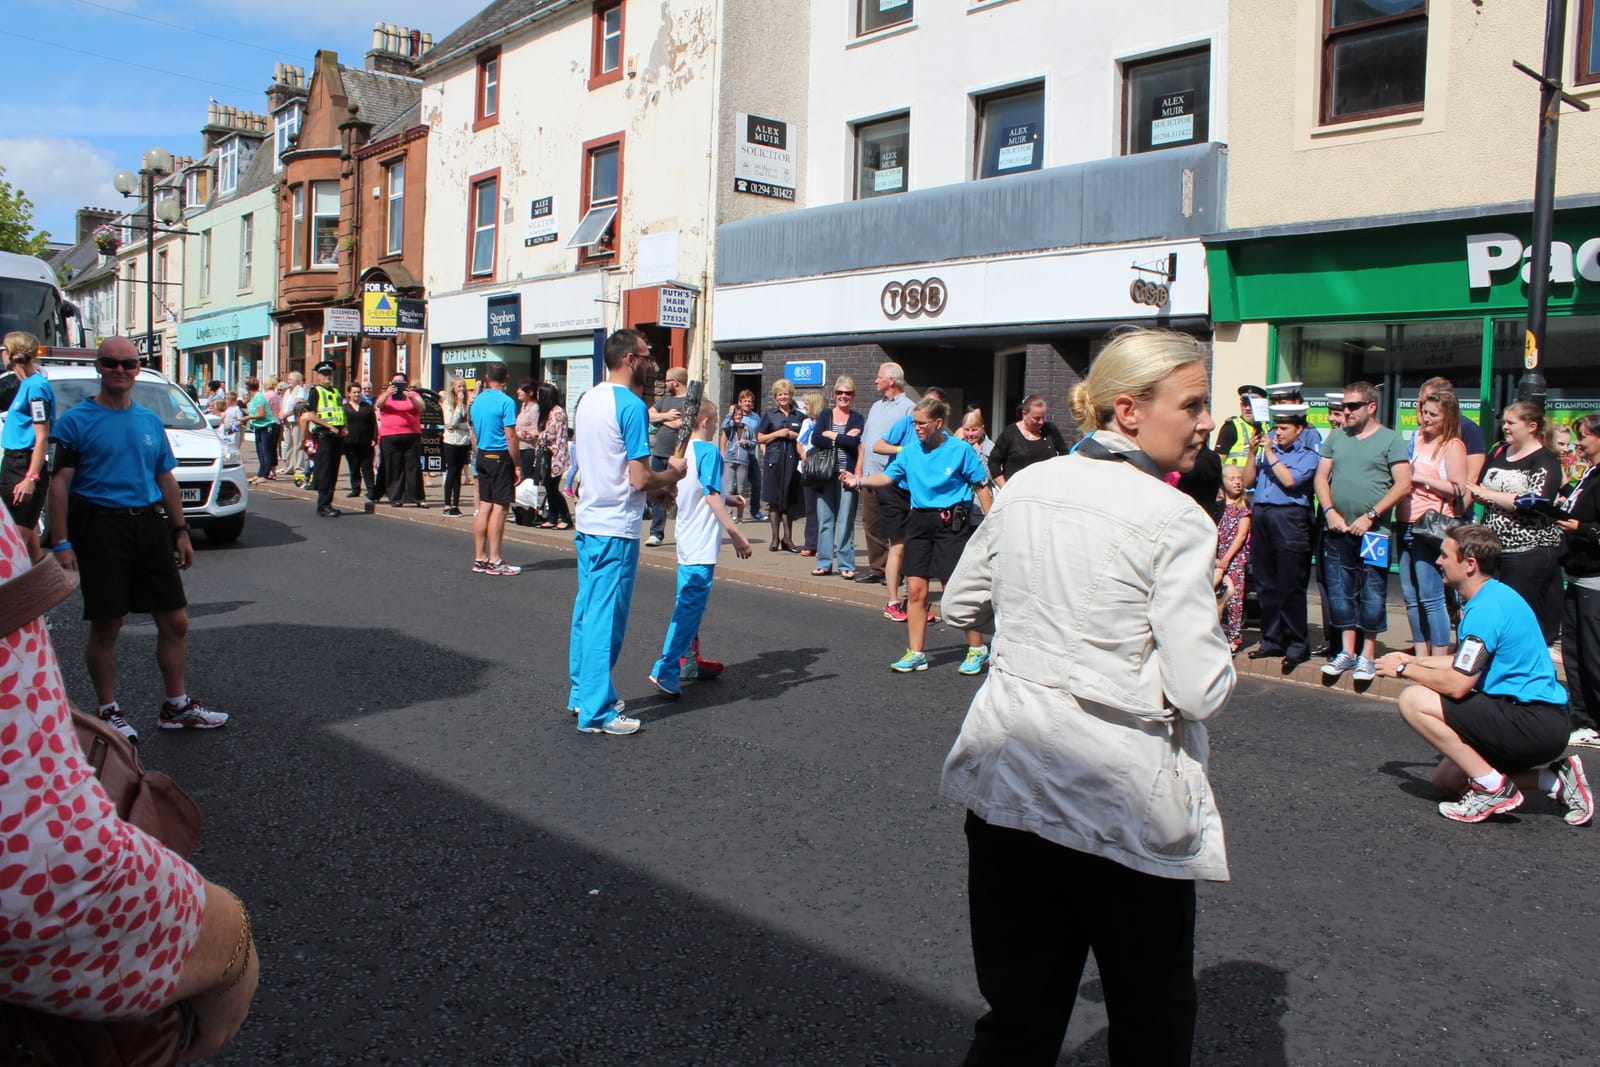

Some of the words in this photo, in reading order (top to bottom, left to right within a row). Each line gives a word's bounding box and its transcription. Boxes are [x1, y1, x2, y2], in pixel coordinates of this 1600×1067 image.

[1162, 96, 1184, 107] ALEX
[1162, 106, 1184, 117] MUIR
[755, 124, 779, 136] ALEX
[1009, 127, 1028, 136] ALEX
[754, 133, 780, 144] MUIR
[1008, 136, 1026, 145] MUIR
[741, 145, 791, 163] SOLICITOR
[882, 152, 897, 160] ALEX
[750, 183, 771, 194] 01294
[772, 187, 793, 199] 311422
[365, 283, 381, 292] FOR
[384, 284, 396, 292] SA
[1133, 281, 1168, 305] TSB
[662, 289, 690, 298] RUTH'S
[884, 280, 944, 314] TSB
[399, 309, 423, 318] Stephen
[663, 305, 689, 314] SALON
[402, 316, 419, 324] Rowe
[490, 310, 516, 326] Stephen
[493, 325, 511, 336] Rowe
[445, 349, 487, 361] OPTICIANS
[454, 368, 463, 377] TO
[465, 367, 476, 378] LET
